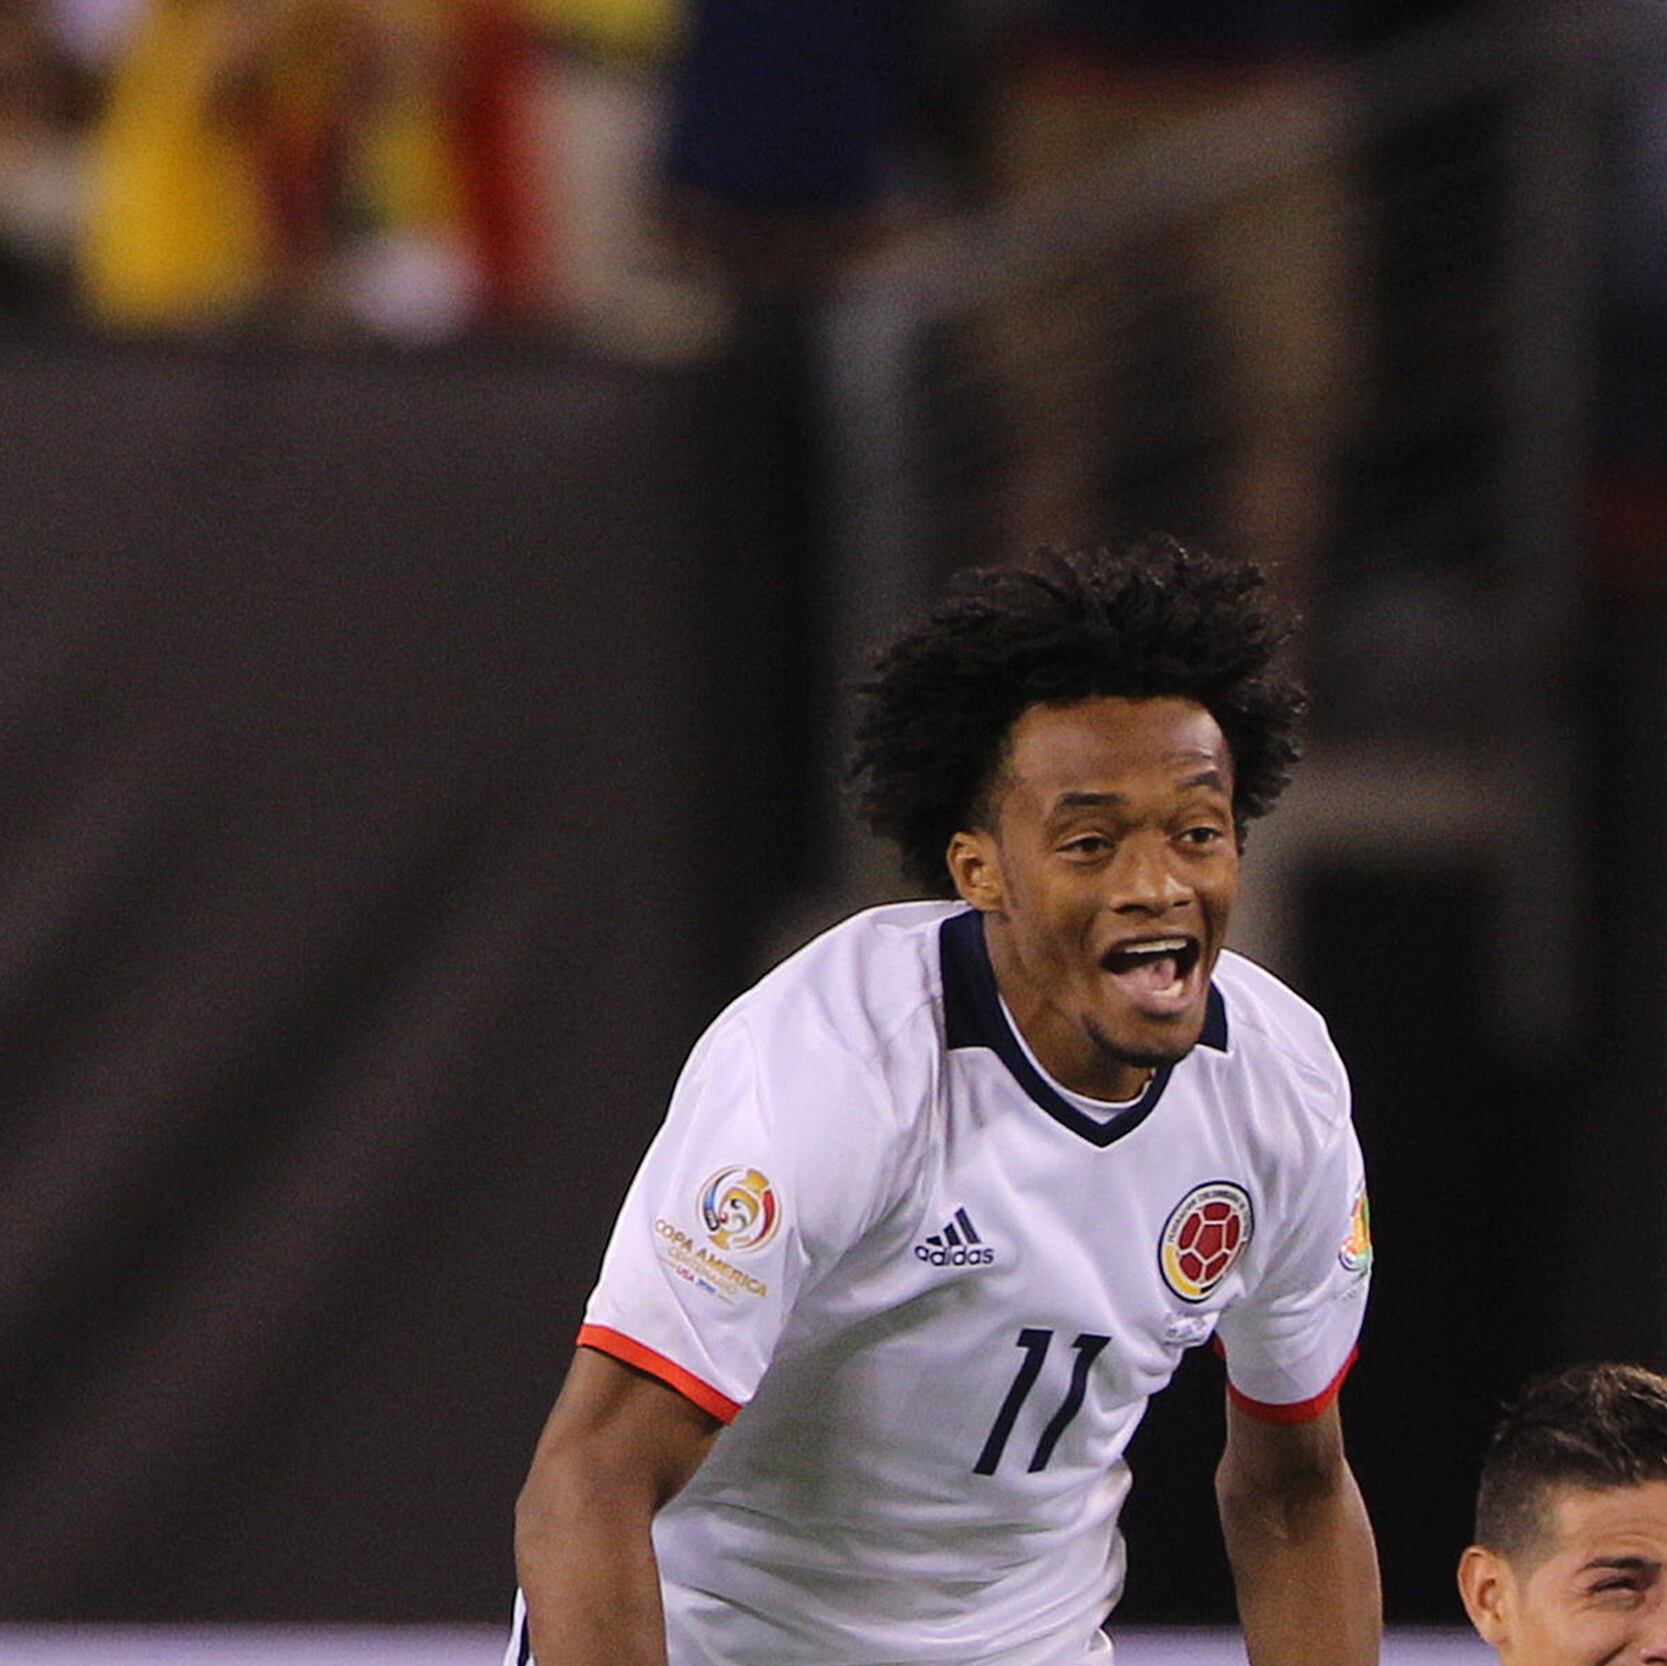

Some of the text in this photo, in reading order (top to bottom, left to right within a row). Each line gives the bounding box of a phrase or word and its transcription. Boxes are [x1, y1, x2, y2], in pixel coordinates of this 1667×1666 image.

[656, 1219, 768, 1297] COPA AMERICA
[914, 1246, 994, 1267] adidas
[972, 1328, 1112, 1476] 11
